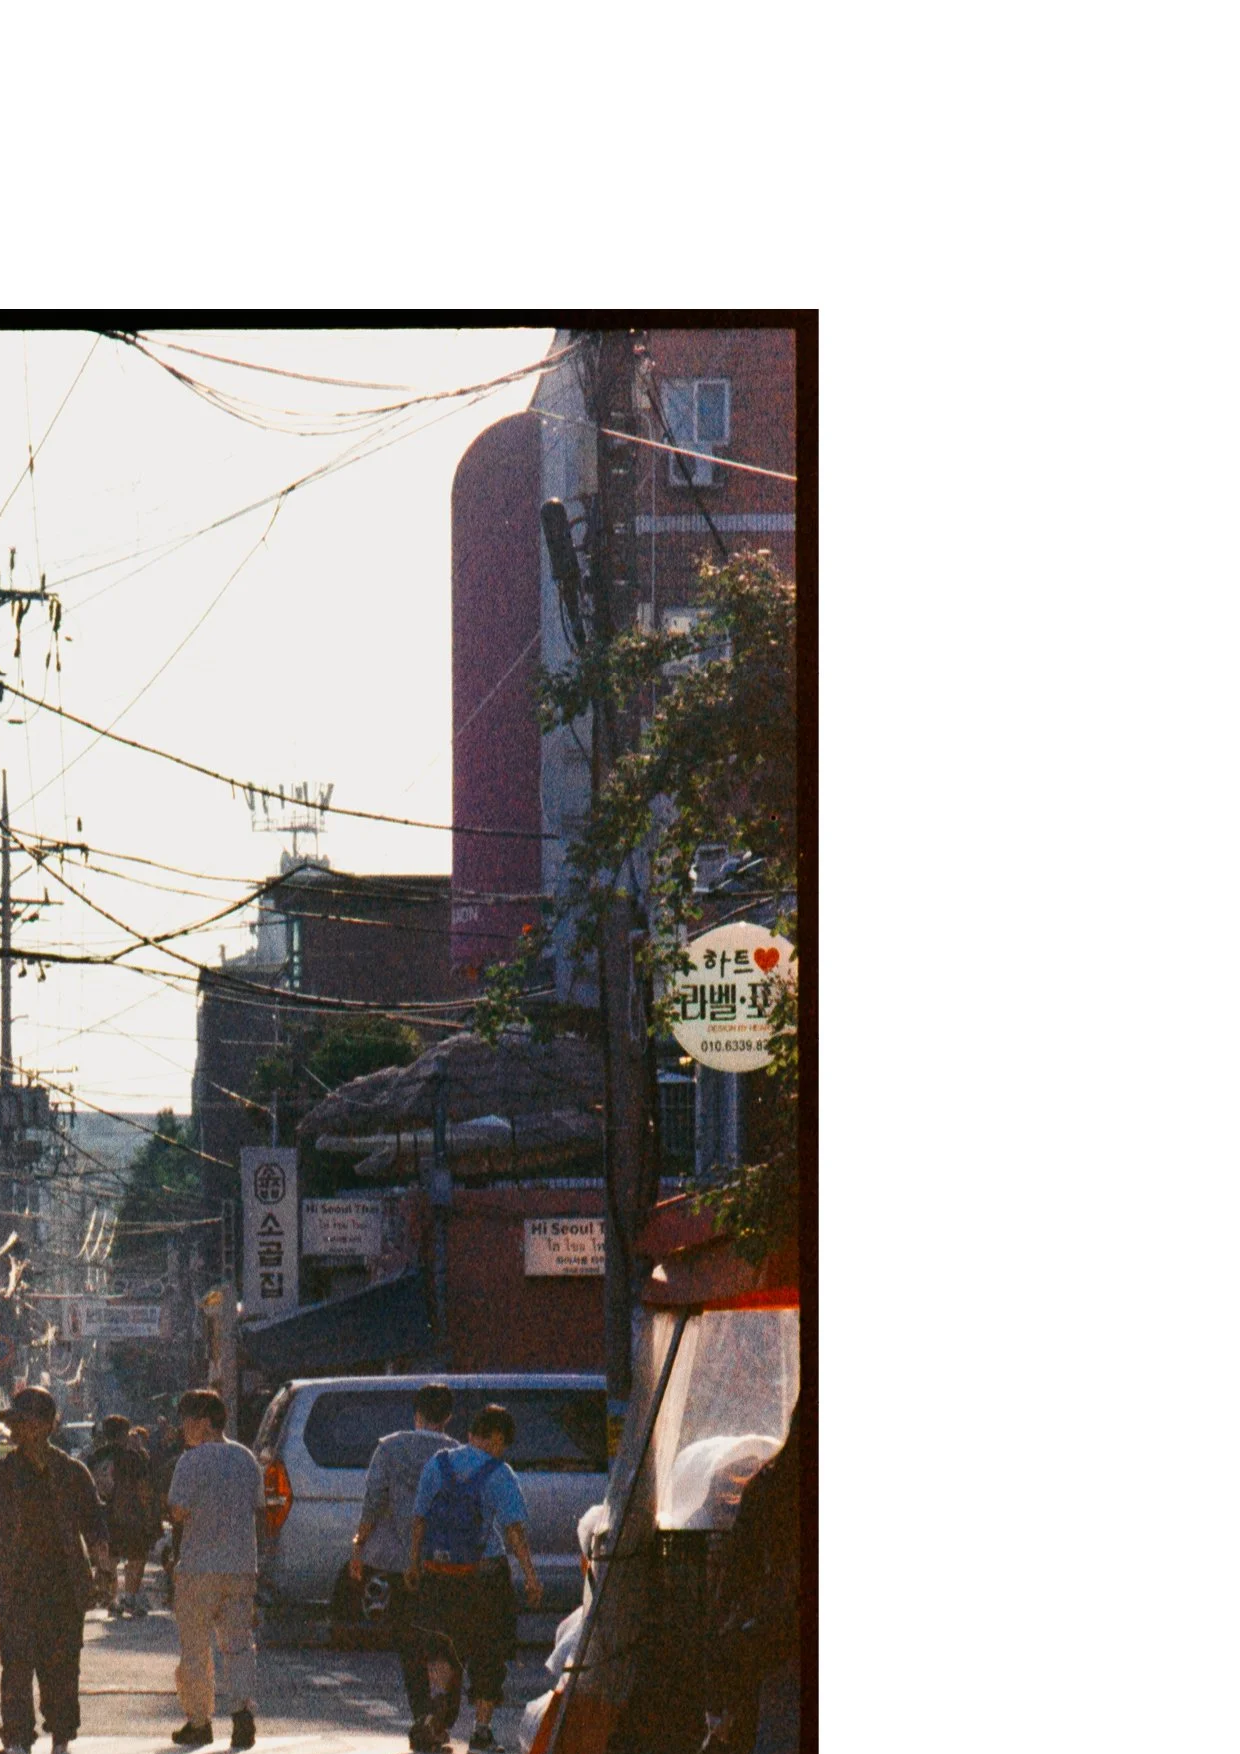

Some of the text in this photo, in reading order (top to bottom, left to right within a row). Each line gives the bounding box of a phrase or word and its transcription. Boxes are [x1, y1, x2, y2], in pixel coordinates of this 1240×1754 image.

[703, 949, 754, 978] 하트
[531, 1222, 547, 1235] Hi
[551, 1222, 594, 1235] Seoul
